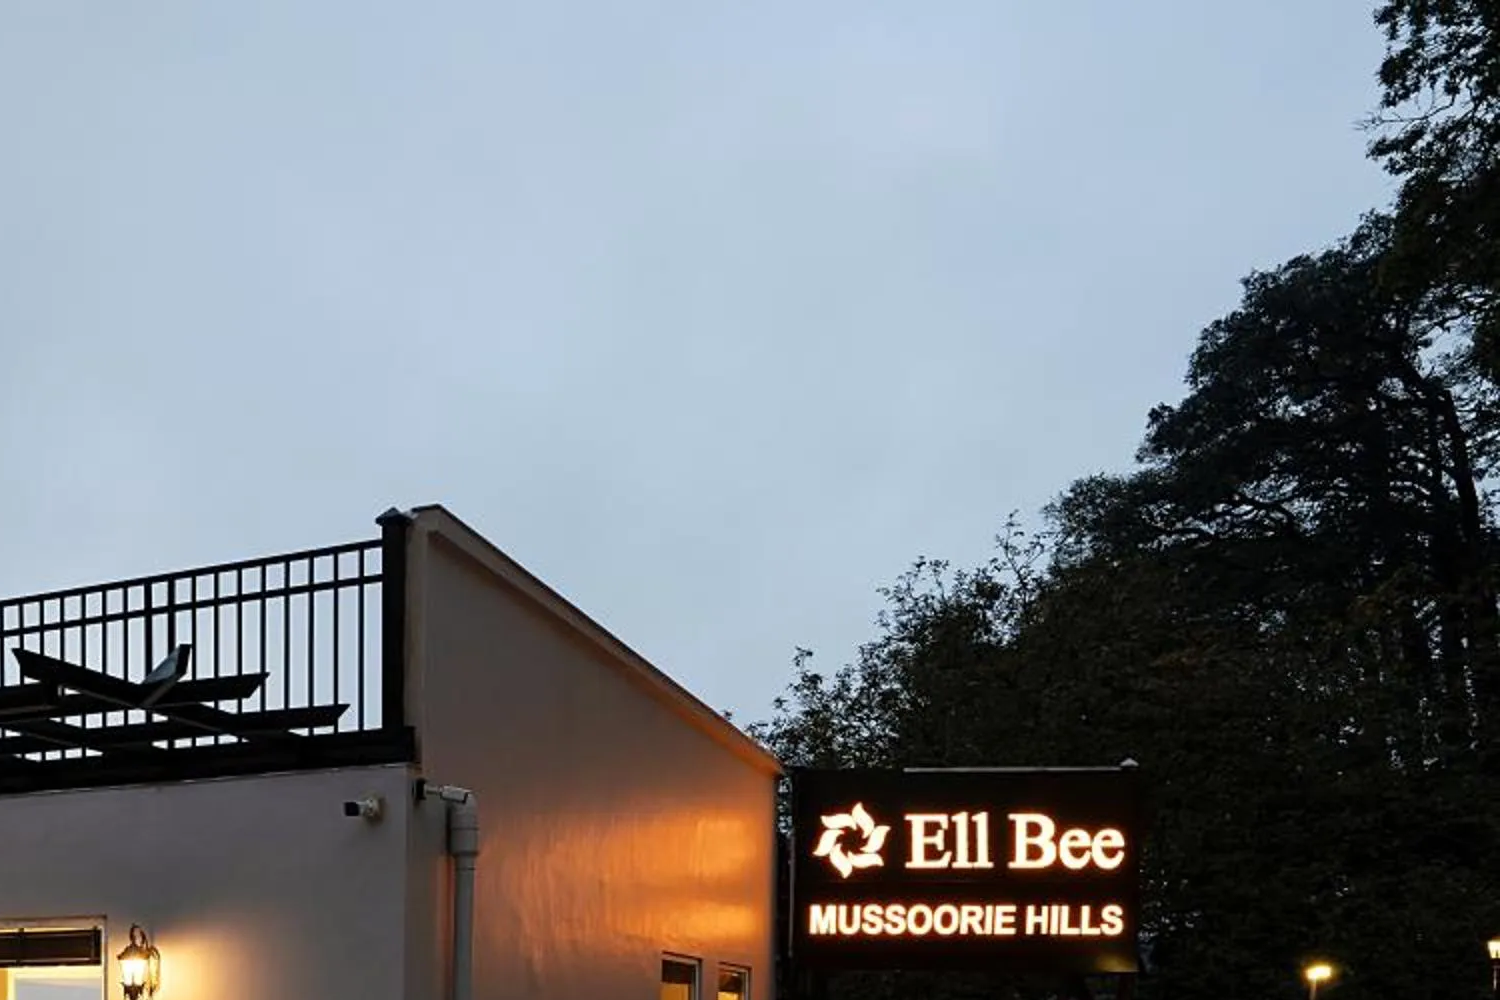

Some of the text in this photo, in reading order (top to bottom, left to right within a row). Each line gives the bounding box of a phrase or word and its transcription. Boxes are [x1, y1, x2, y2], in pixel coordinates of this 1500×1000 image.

[904, 811, 1125, 870] Ell Bee
[808, 904, 1124, 936] MUSSOORIE HILLS
